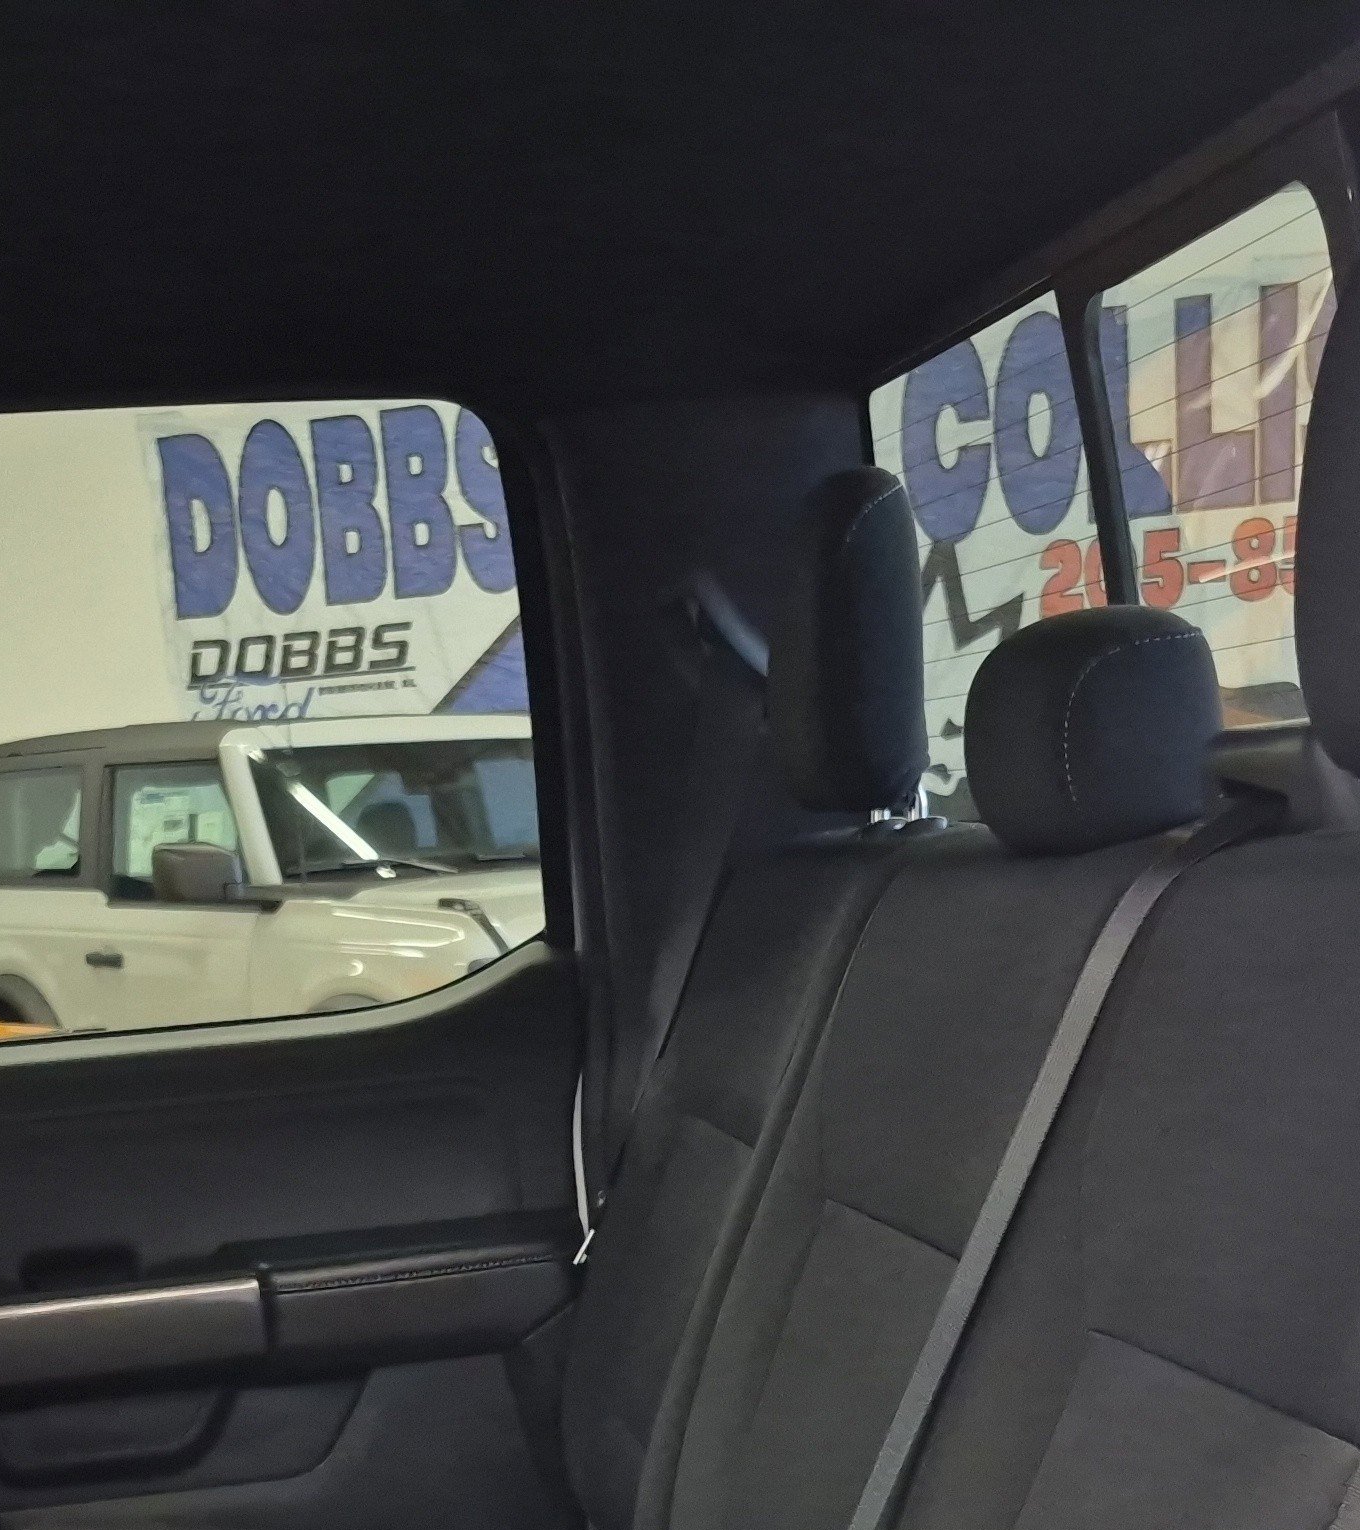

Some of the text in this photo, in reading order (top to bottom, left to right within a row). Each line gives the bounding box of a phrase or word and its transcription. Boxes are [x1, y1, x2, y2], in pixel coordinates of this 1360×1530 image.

[156, 404, 517, 620] DOBBS
[189, 621, 414, 685] DOBBS
[192, 674, 316, 722] Ford
